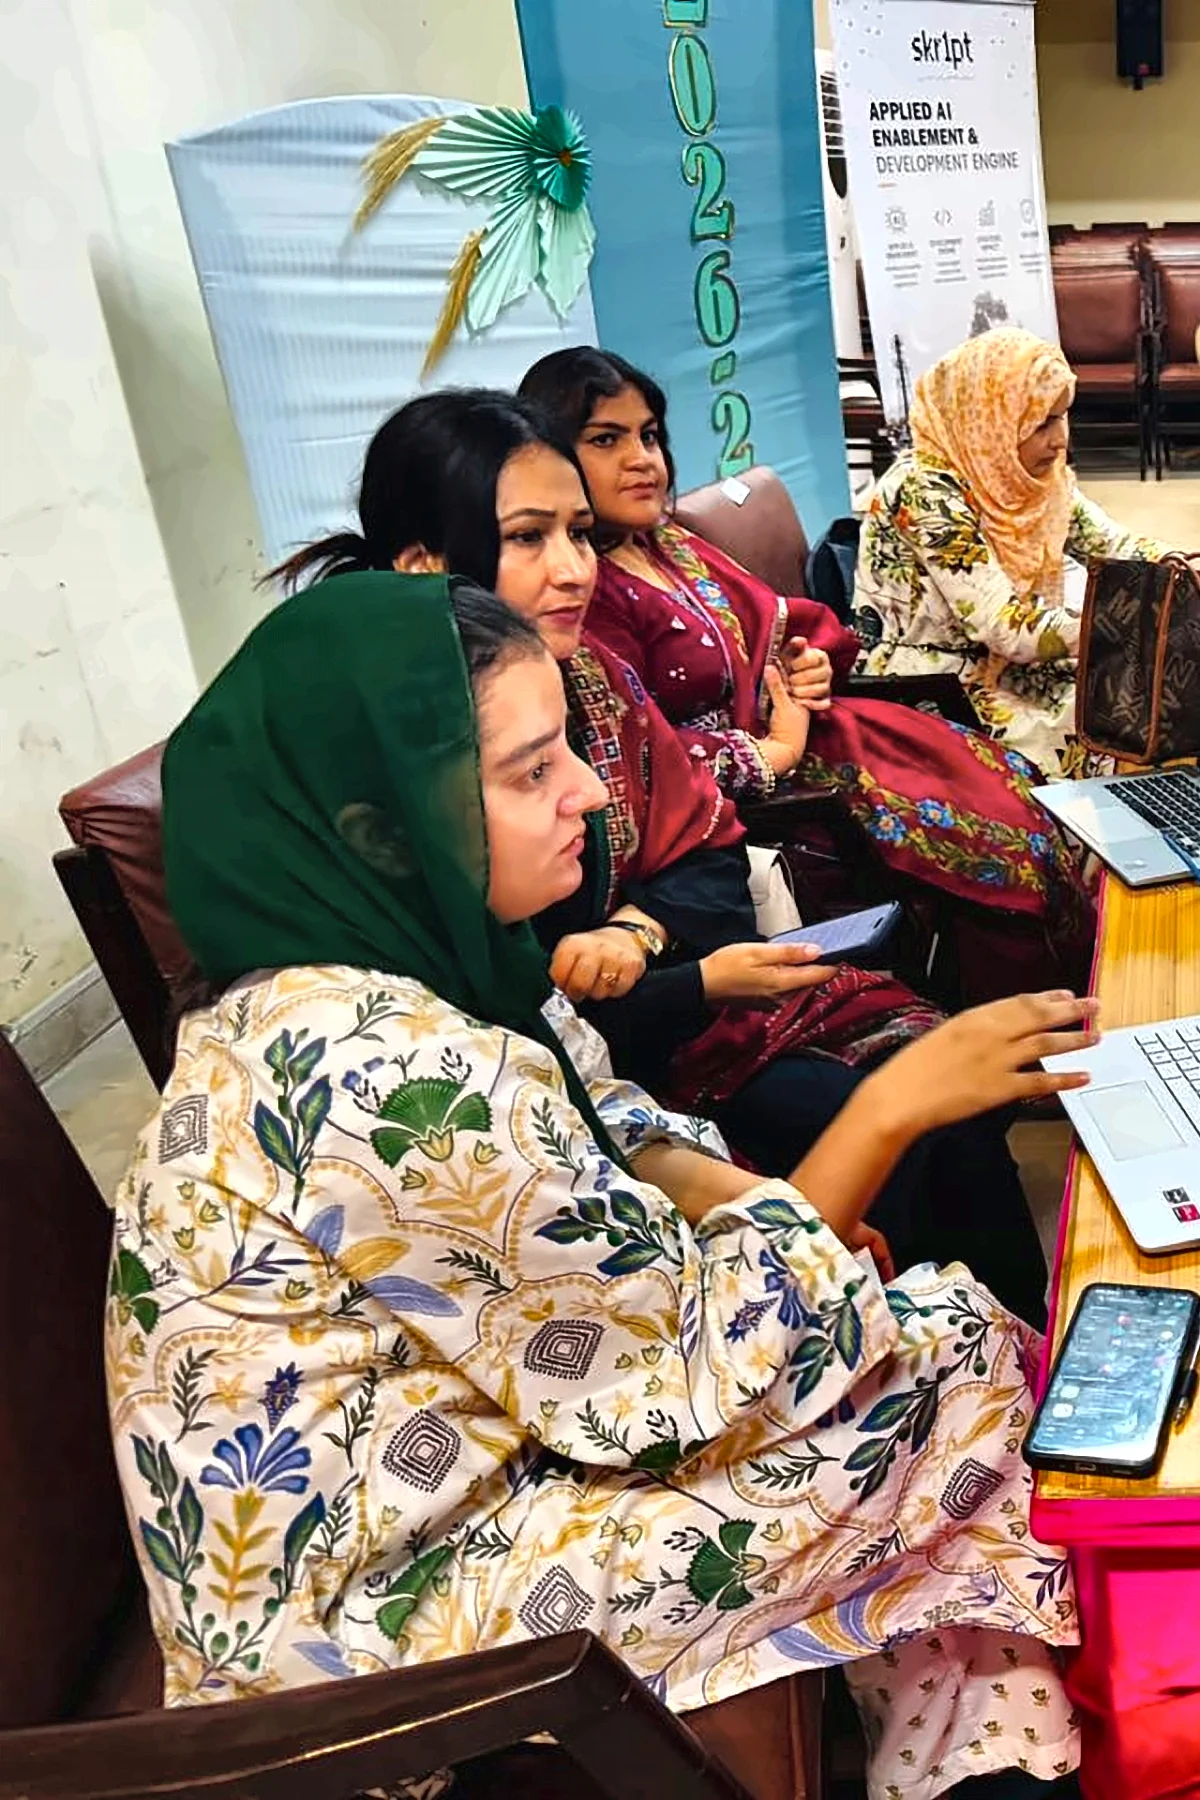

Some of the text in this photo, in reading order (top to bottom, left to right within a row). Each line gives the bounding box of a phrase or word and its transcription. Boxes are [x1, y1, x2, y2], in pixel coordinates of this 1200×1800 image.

[911, 29, 974, 71] skr1pt
[869, 101, 952, 121] APPLIED AI
[872, 127, 978, 147] ENABLEMENT &
[876, 151, 1020, 173] DEVELOPMENT ENGINE
